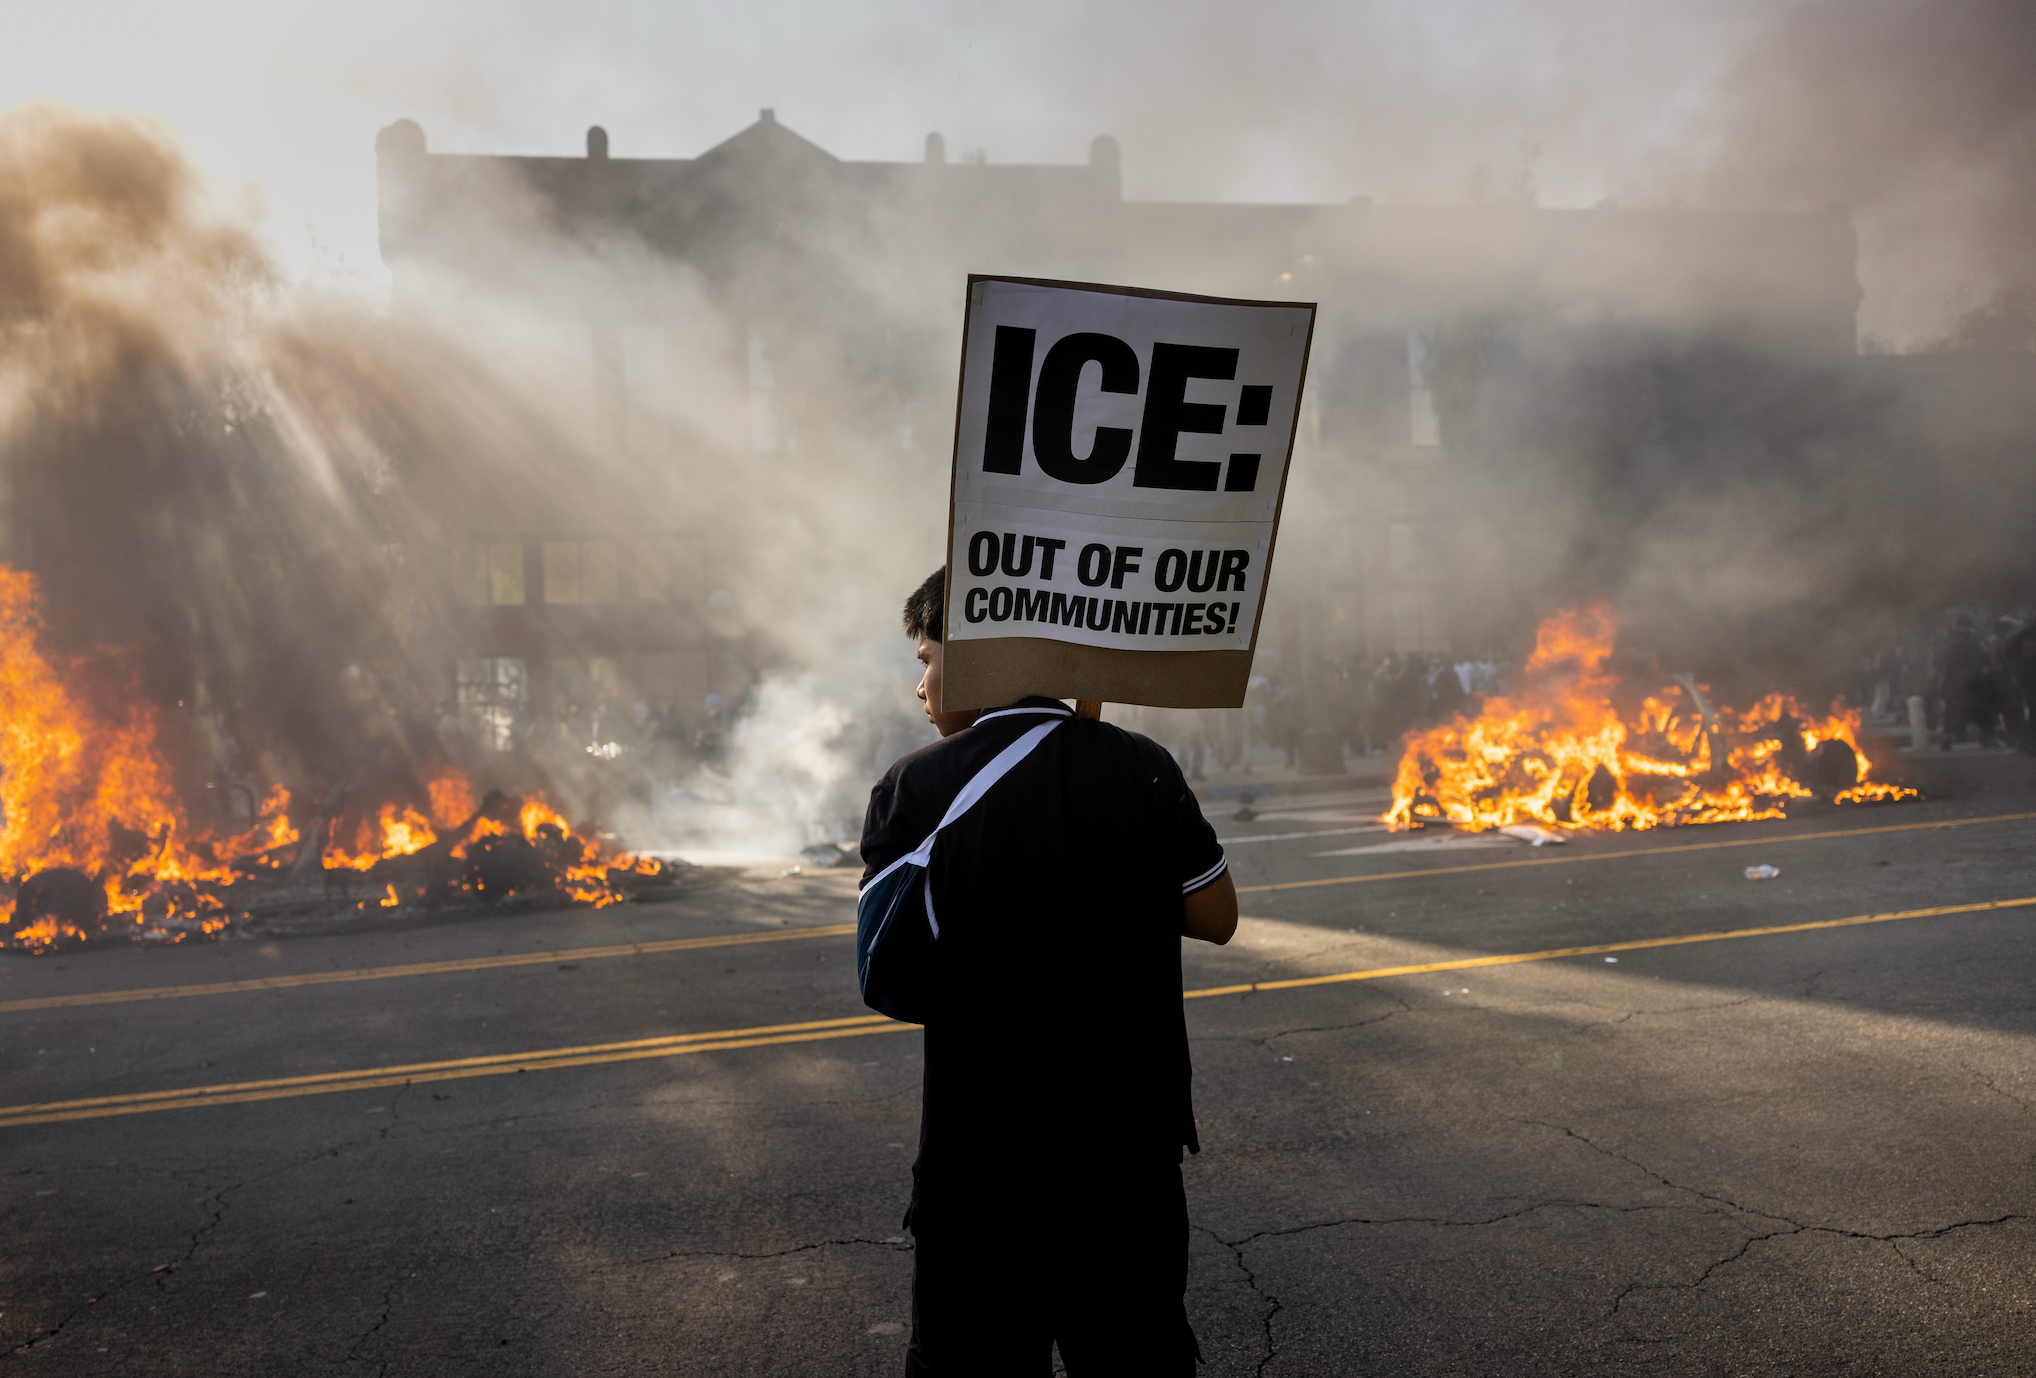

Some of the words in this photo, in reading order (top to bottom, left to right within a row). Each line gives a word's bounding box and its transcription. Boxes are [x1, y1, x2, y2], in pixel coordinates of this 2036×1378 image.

[982, 324, 1274, 493] ICE:
[968, 530, 1066, 581] OUT
[1077, 543, 1144, 590] OF
[1154, 548, 1250, 593] OUR
[964, 586, 1241, 636] COMMUNITIES!
